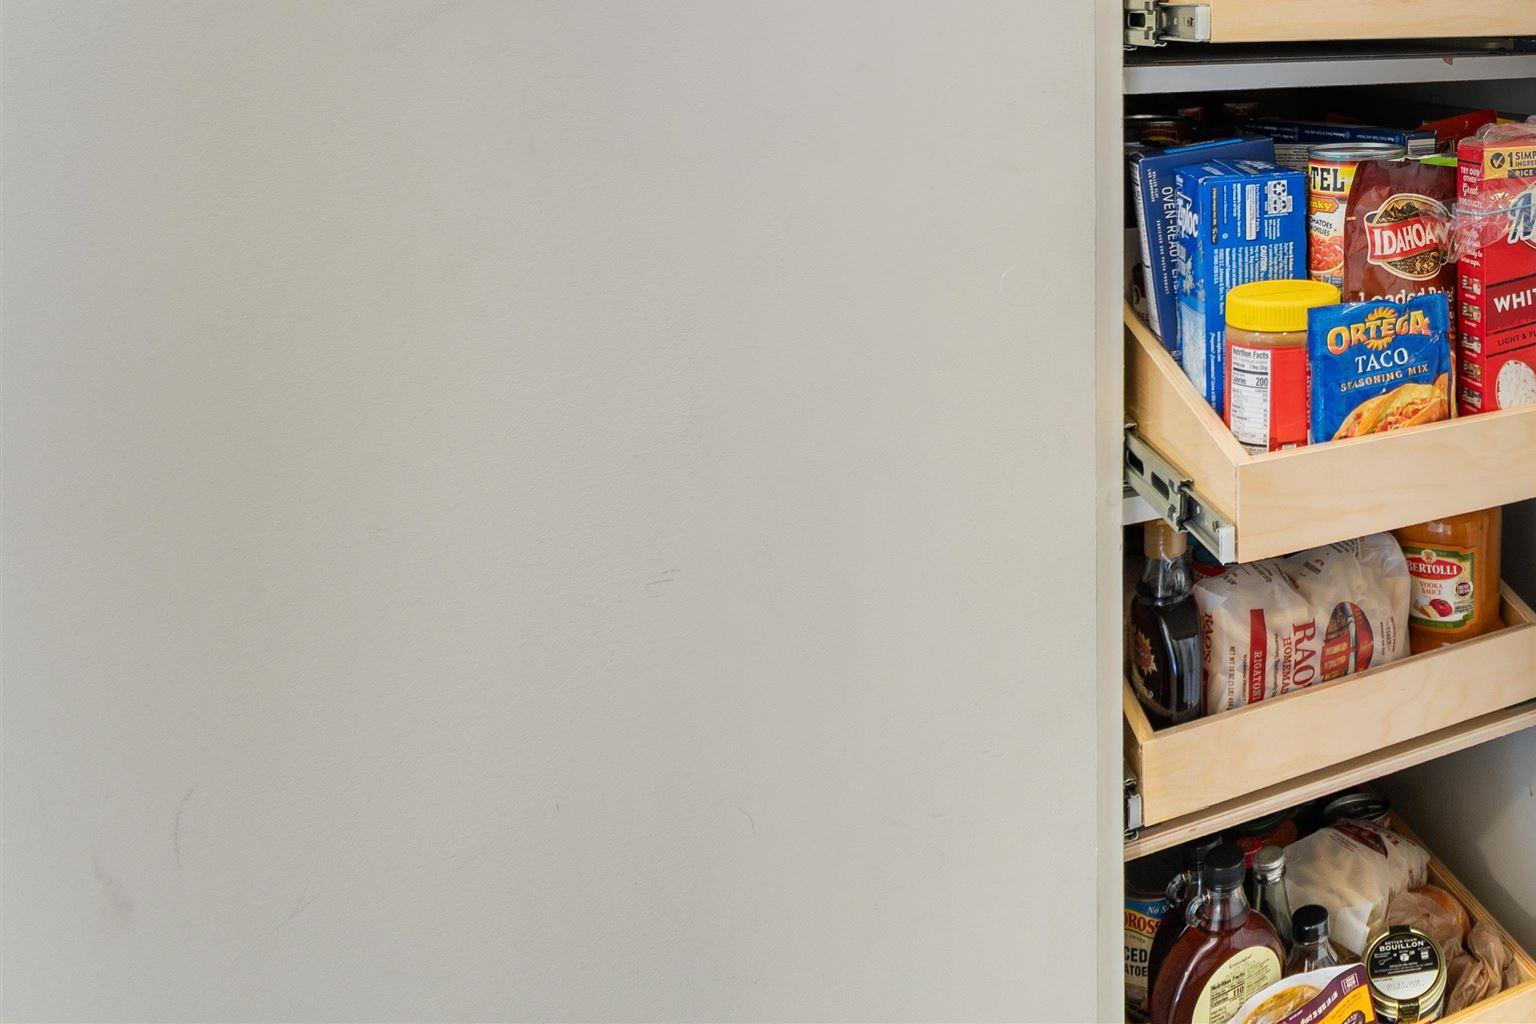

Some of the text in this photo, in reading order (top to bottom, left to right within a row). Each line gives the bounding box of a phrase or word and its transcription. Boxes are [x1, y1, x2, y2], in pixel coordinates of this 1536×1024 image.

[1508, 153, 1514, 168] 1
[1460, 166, 1480, 176] TRY OUR
[1515, 169, 1534, 177] RICE
[1463, 183, 1479, 196] Great
[1312, 200, 1331, 212] nky
[1373, 223, 1452, 256] IDAHOAN
[1326, 310, 1432, 356] ORTEGA
[1497, 334, 1521, 346] LIGHT
[1232, 347, 1269, 359] Nutrition Facts
[1355, 347, 1409, 373] TACO
[1256, 377, 1269, 387] 200
[1340, 364, 1429, 392] SEASONING MIX
[1407, 560, 1457, 575] BERTOLLI
[1281, 636, 1293, 694] HOMEMAD
[1252, 651, 1263, 702] RIGATONI
[1379, 941, 1425, 953] BOUILLON
[1384, 939, 1403, 947] BETTER
[1233, 986, 1244, 997] 110
